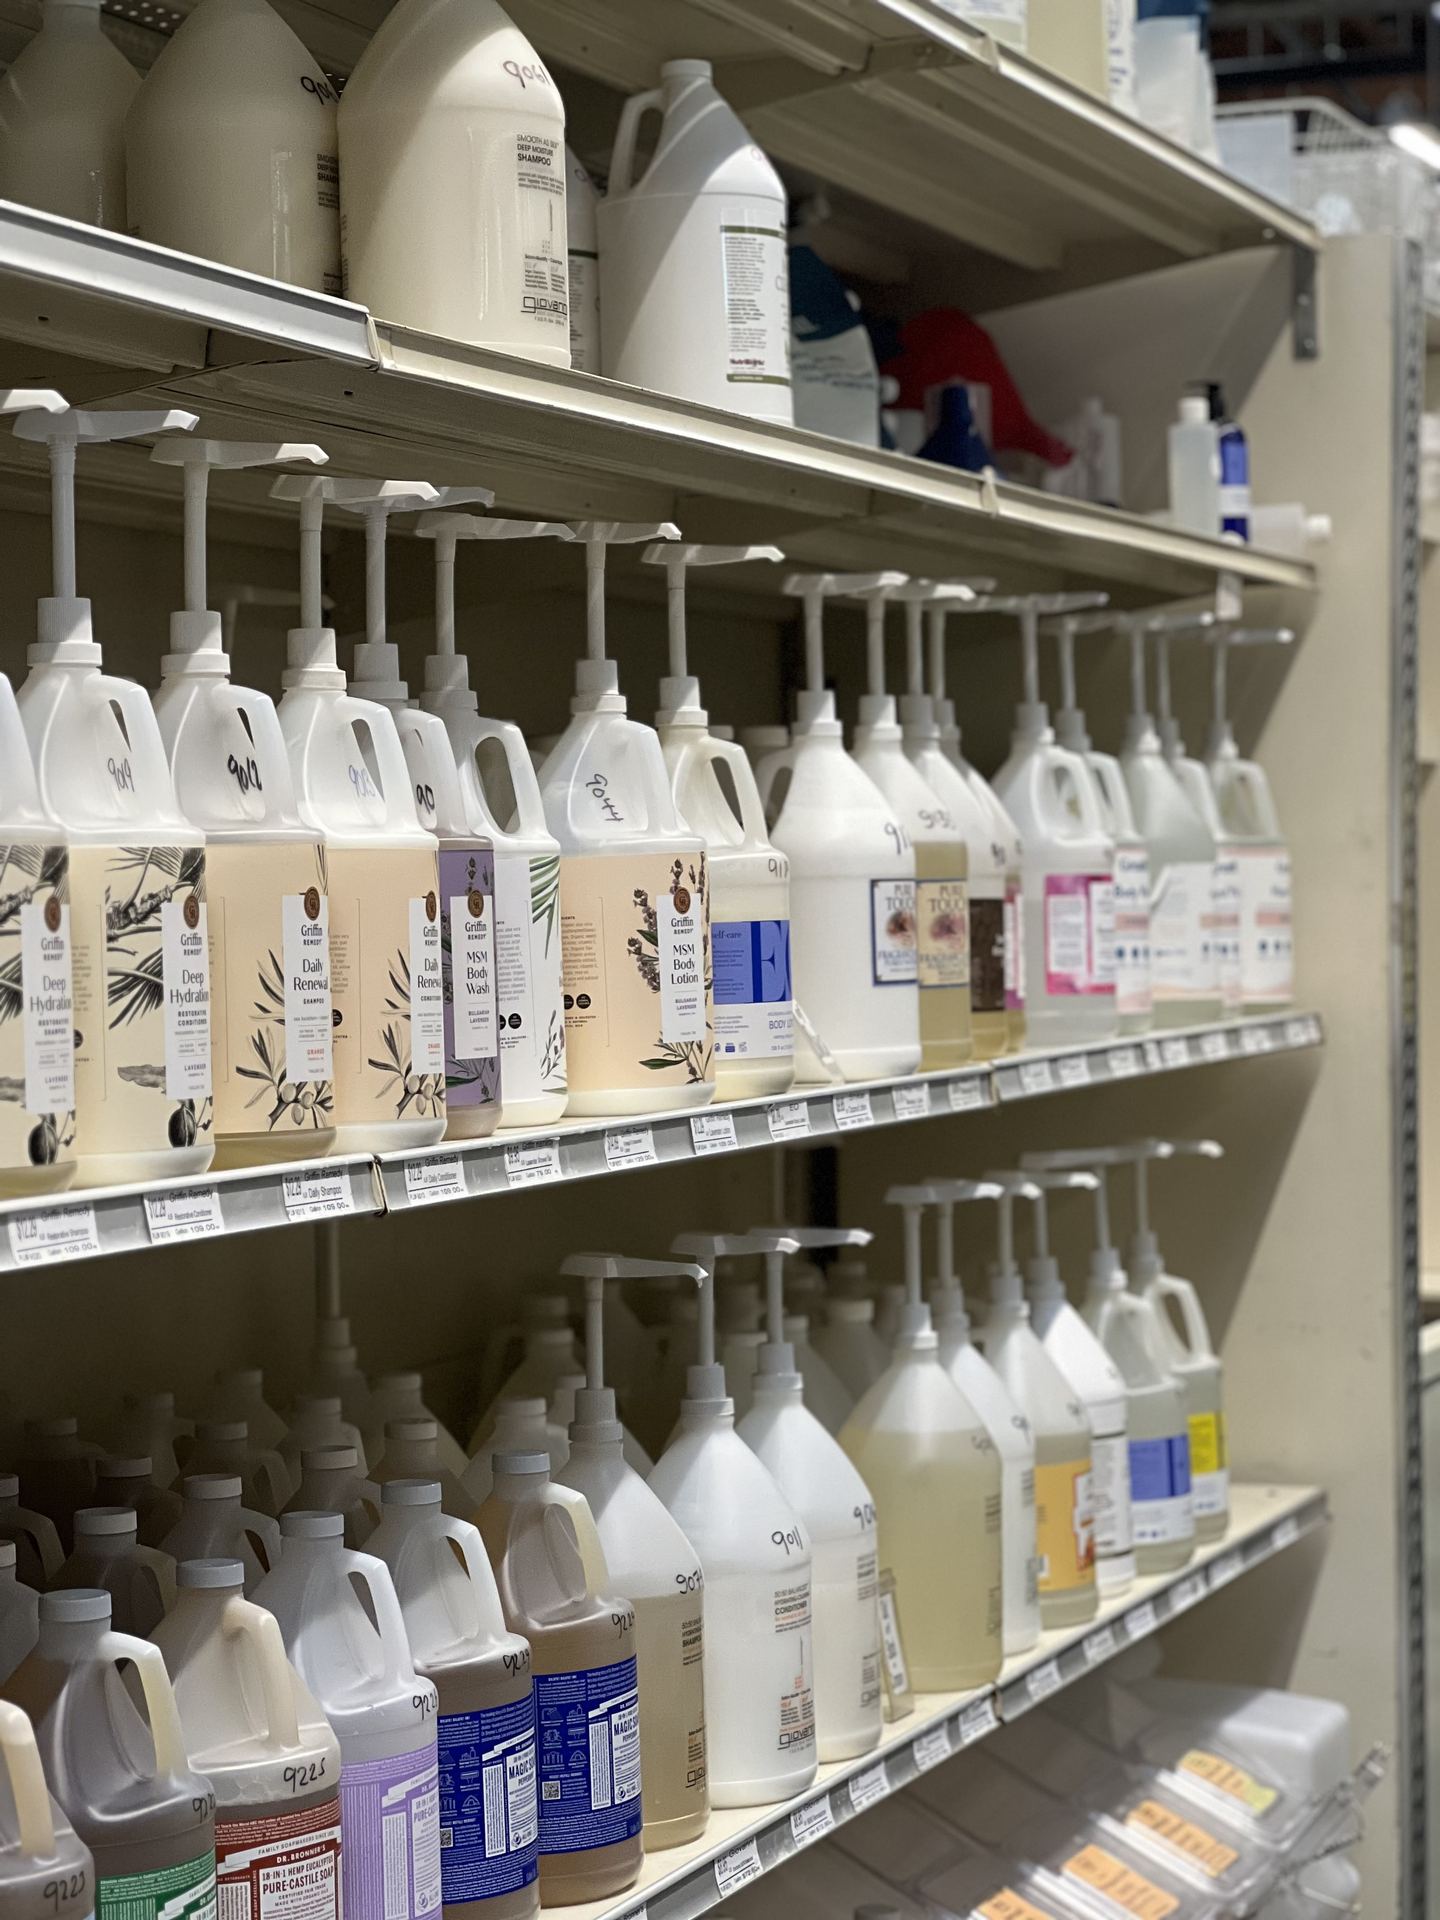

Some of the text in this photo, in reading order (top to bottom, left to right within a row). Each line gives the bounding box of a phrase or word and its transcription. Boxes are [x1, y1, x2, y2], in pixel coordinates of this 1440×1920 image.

[516, 134, 542, 145] SMOOTH
[517, 153, 551, 166] SHAMPOO
[464, 920, 487, 932] Griffin
[671, 915, 694, 928] Griffin
[300, 923, 323, 937] Griffin
[467, 933, 487, 941] REMEDY
[41, 936, 64, 951] Griffin
[180, 932, 203, 946] Griffin
[303, 938, 322, 946] REMEDY
[673, 943, 695, 956] MSM
[466, 950, 488, 964] MSM
[302, 958, 324, 976] Daily
[673, 958, 696, 973] Body
[182, 969, 205, 987] Deep
[467, 966, 488, 980] Body
[671, 972, 699, 985] Lotion
[43, 975, 66, 993] Deep
[293, 976, 329, 991] Renewal
[417, 974, 441, 989] Renewa
[466, 982, 490, 995] Wash
[170, 987, 210, 1008] Hydration
[303, 997, 324, 1005] SHAMPOO
[177, 1009, 207, 1017] RESTORATIVE
[177, 1018, 207, 1027] CONDITIONER
[769, 1020, 785, 1030] BODY
[425, 1157, 438, 1167] Griffin
[439, 1153, 458, 1165] Remedy
[304, 1171, 320, 1182] Griffin
[321, 1169, 343, 1180] Remedy
[169, 1191, 187, 1203] Griffin
[188, 1187, 214, 1199] Remedy
[308, 1186, 342, 1199] Daily Shampoo
[771, 1526, 803, 1556] 9011
[613, 1719, 632, 1737] MAGIC
[283, 1757, 326, 1793] 9225
[258, 1845, 280, 1856] FAMILY
[280, 1836, 315, 1850] SOAPMAKERS
[276, 1844, 327, 1864] DR. BRONNER'S
[287, 1866, 305, 1877] HEMP
[305, 1855, 334, 1871] EUCALYPTUS
[262, 1865, 334, 1894] PURE-CASTILE SOAP
[278, 1891, 304, 1900] CERTIFIED
